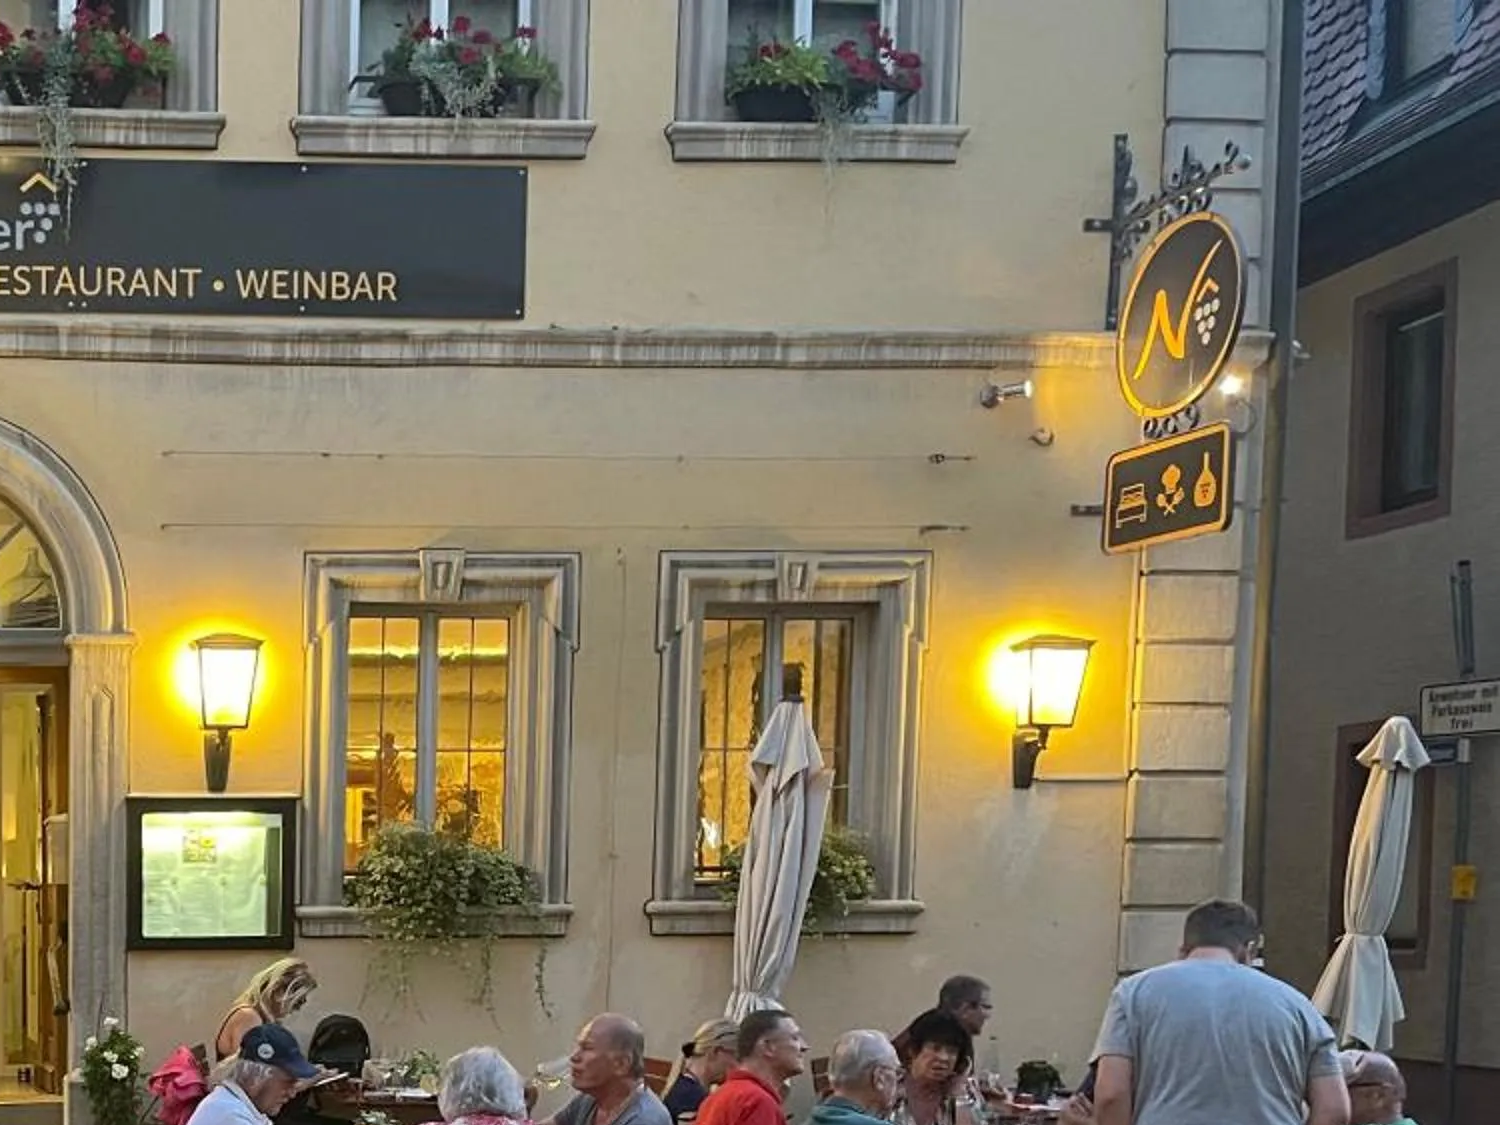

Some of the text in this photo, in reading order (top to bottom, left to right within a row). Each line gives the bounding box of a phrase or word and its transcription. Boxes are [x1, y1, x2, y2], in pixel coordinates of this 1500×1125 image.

[236, 269, 398, 301] WEINBAR
[1133, 238, 1223, 380] N
[1451, 717, 1473, 729] frei
